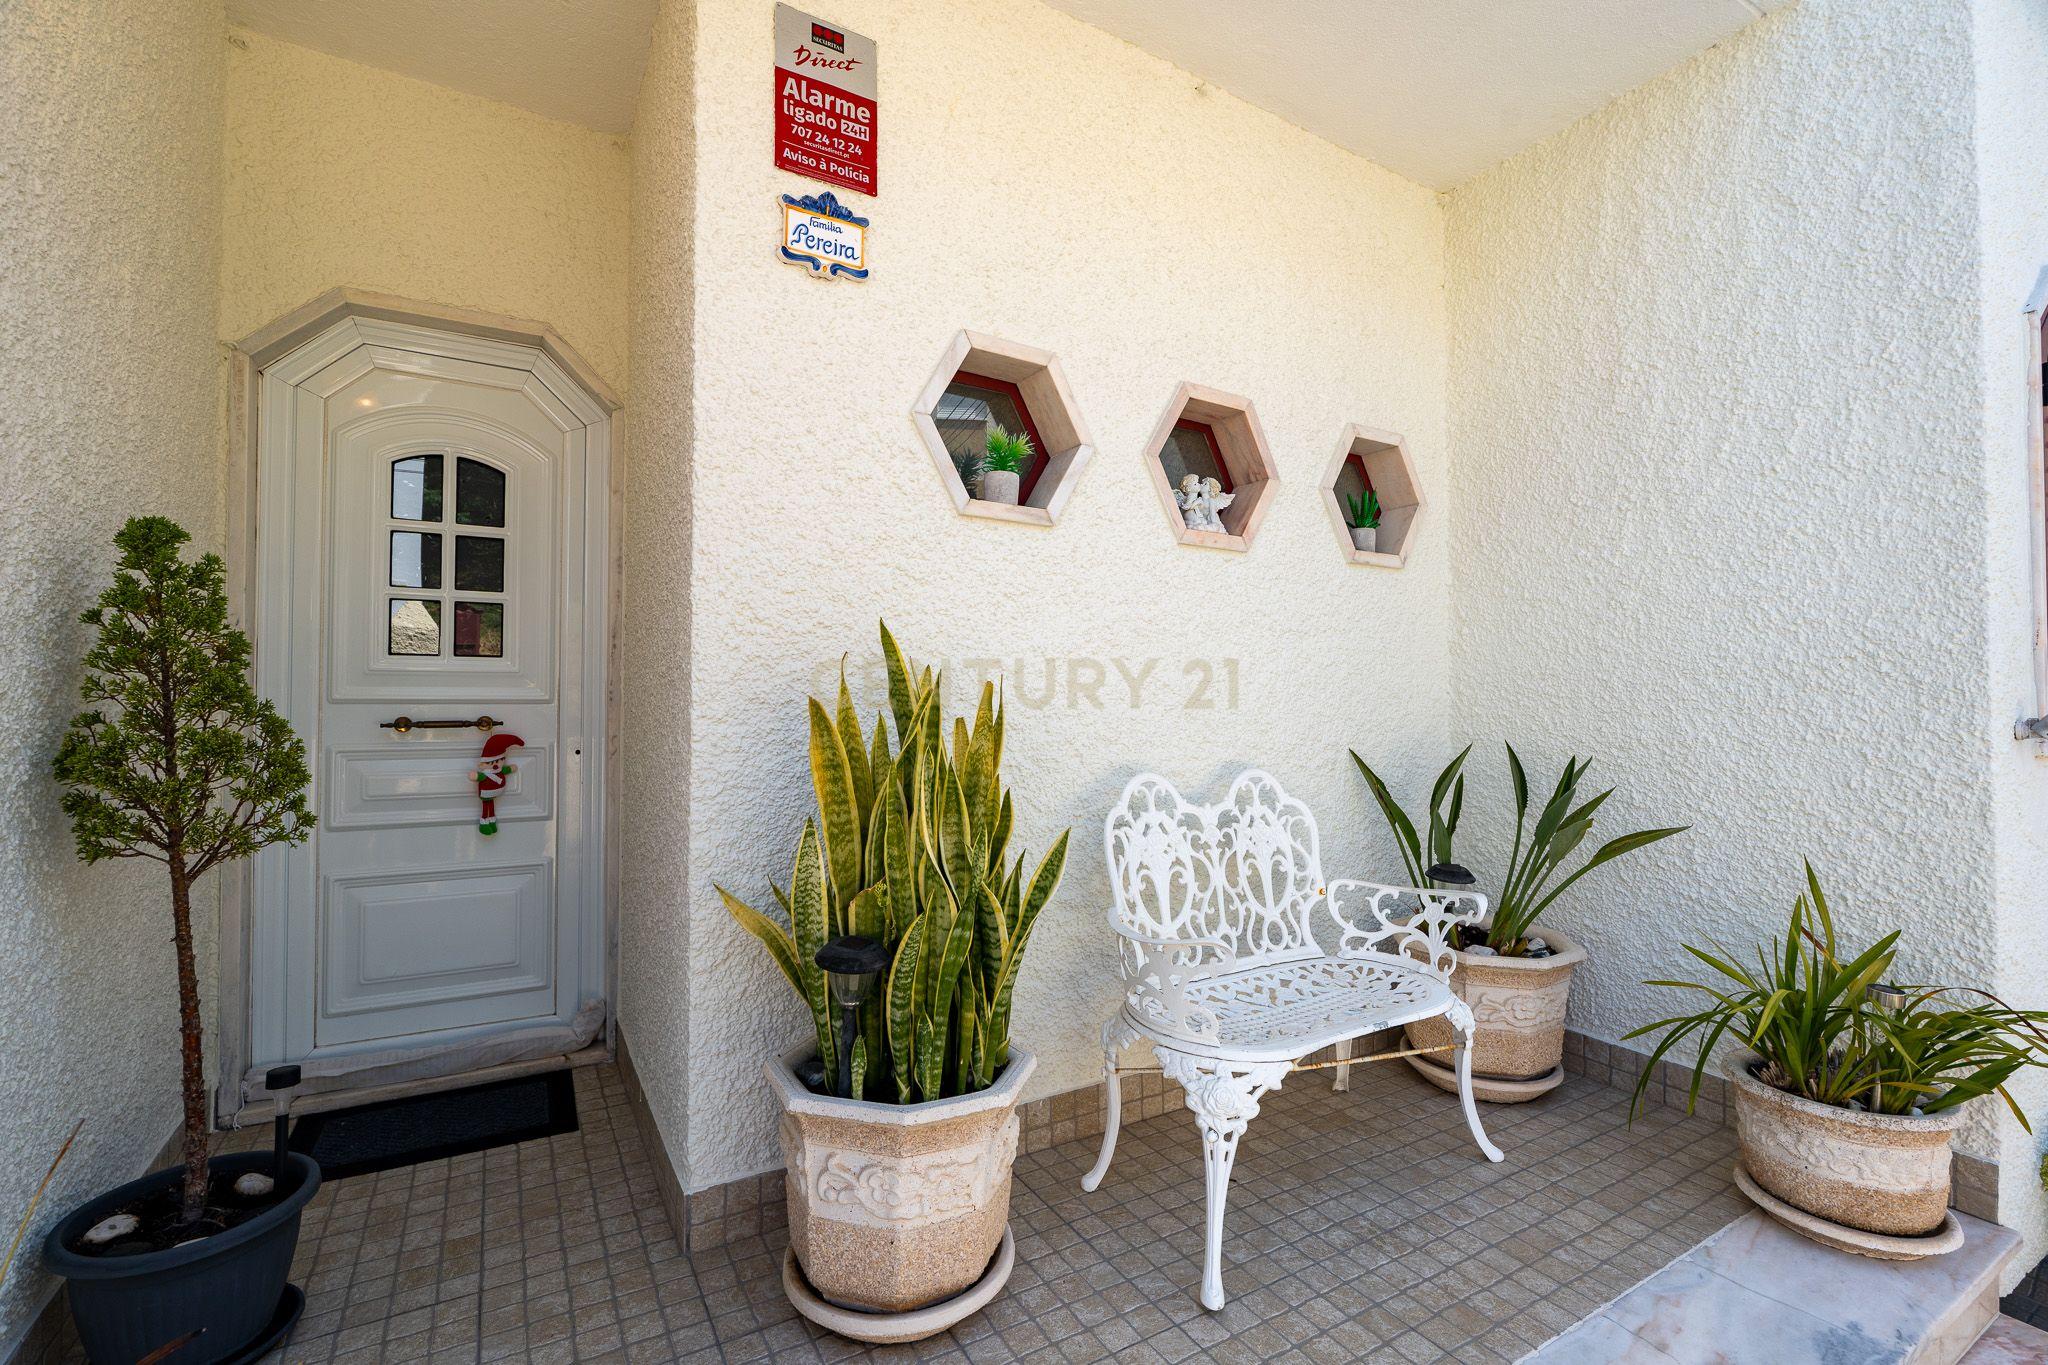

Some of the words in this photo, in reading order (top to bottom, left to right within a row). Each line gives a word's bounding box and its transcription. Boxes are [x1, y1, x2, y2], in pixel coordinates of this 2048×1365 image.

[793, 45, 863, 71] Direct
[812, 36, 844, 52] SECURITAS
[783, 77, 871, 123] Alarme
[783, 98, 837, 130] ligado
[843, 121, 867, 139] 24H
[791, 123, 812, 139] 707
[815, 132, 830, 145] 24
[832, 138, 846, 150] 12
[848, 142, 863, 156] 24
[783, 147, 817, 167] Aviso
[820, 158, 827, 170] à
[830, 162, 870, 183] Polícia
[790, 223, 860, 260] Pereira
